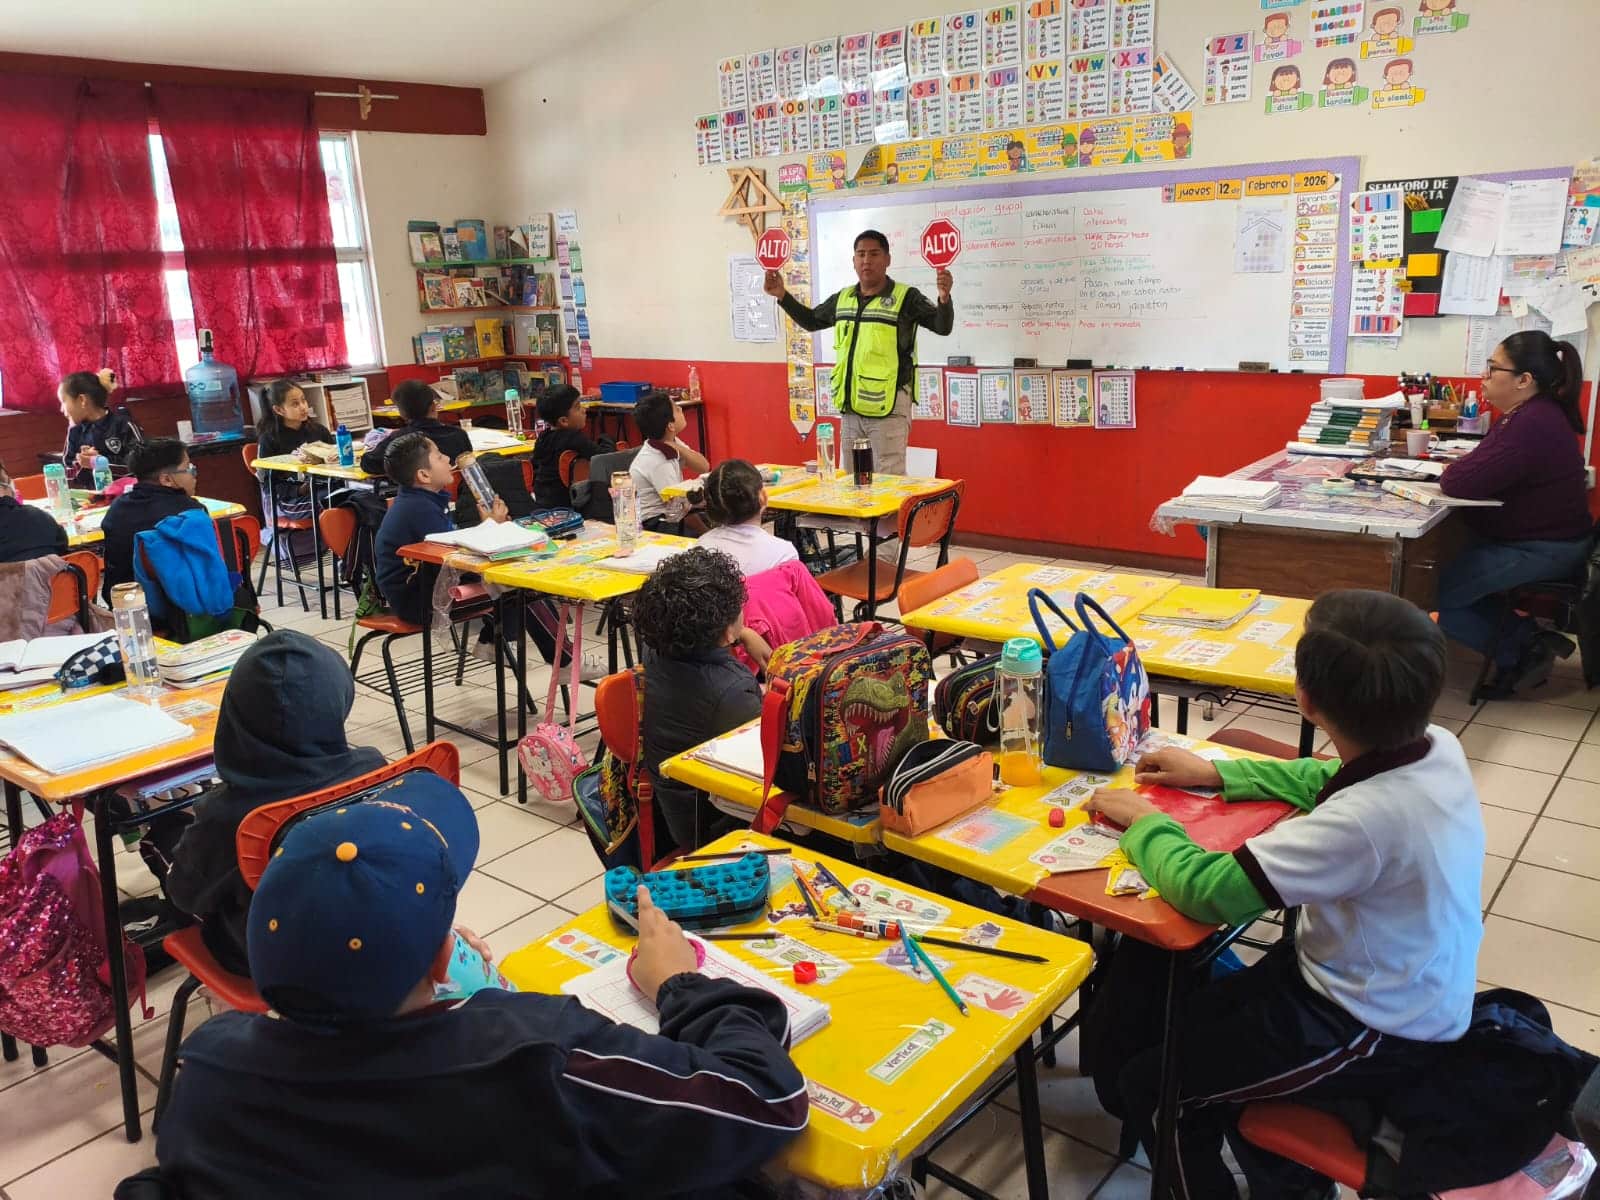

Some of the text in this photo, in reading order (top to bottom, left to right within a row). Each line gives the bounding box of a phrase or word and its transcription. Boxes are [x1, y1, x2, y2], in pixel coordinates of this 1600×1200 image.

[1218, 183, 1229, 195] 12
[1303, 175, 1327, 187] 2026
[1433, 179, 1449, 190] DE
[758, 239, 789, 259] ALTO
[924, 231, 958, 255] ALTO
